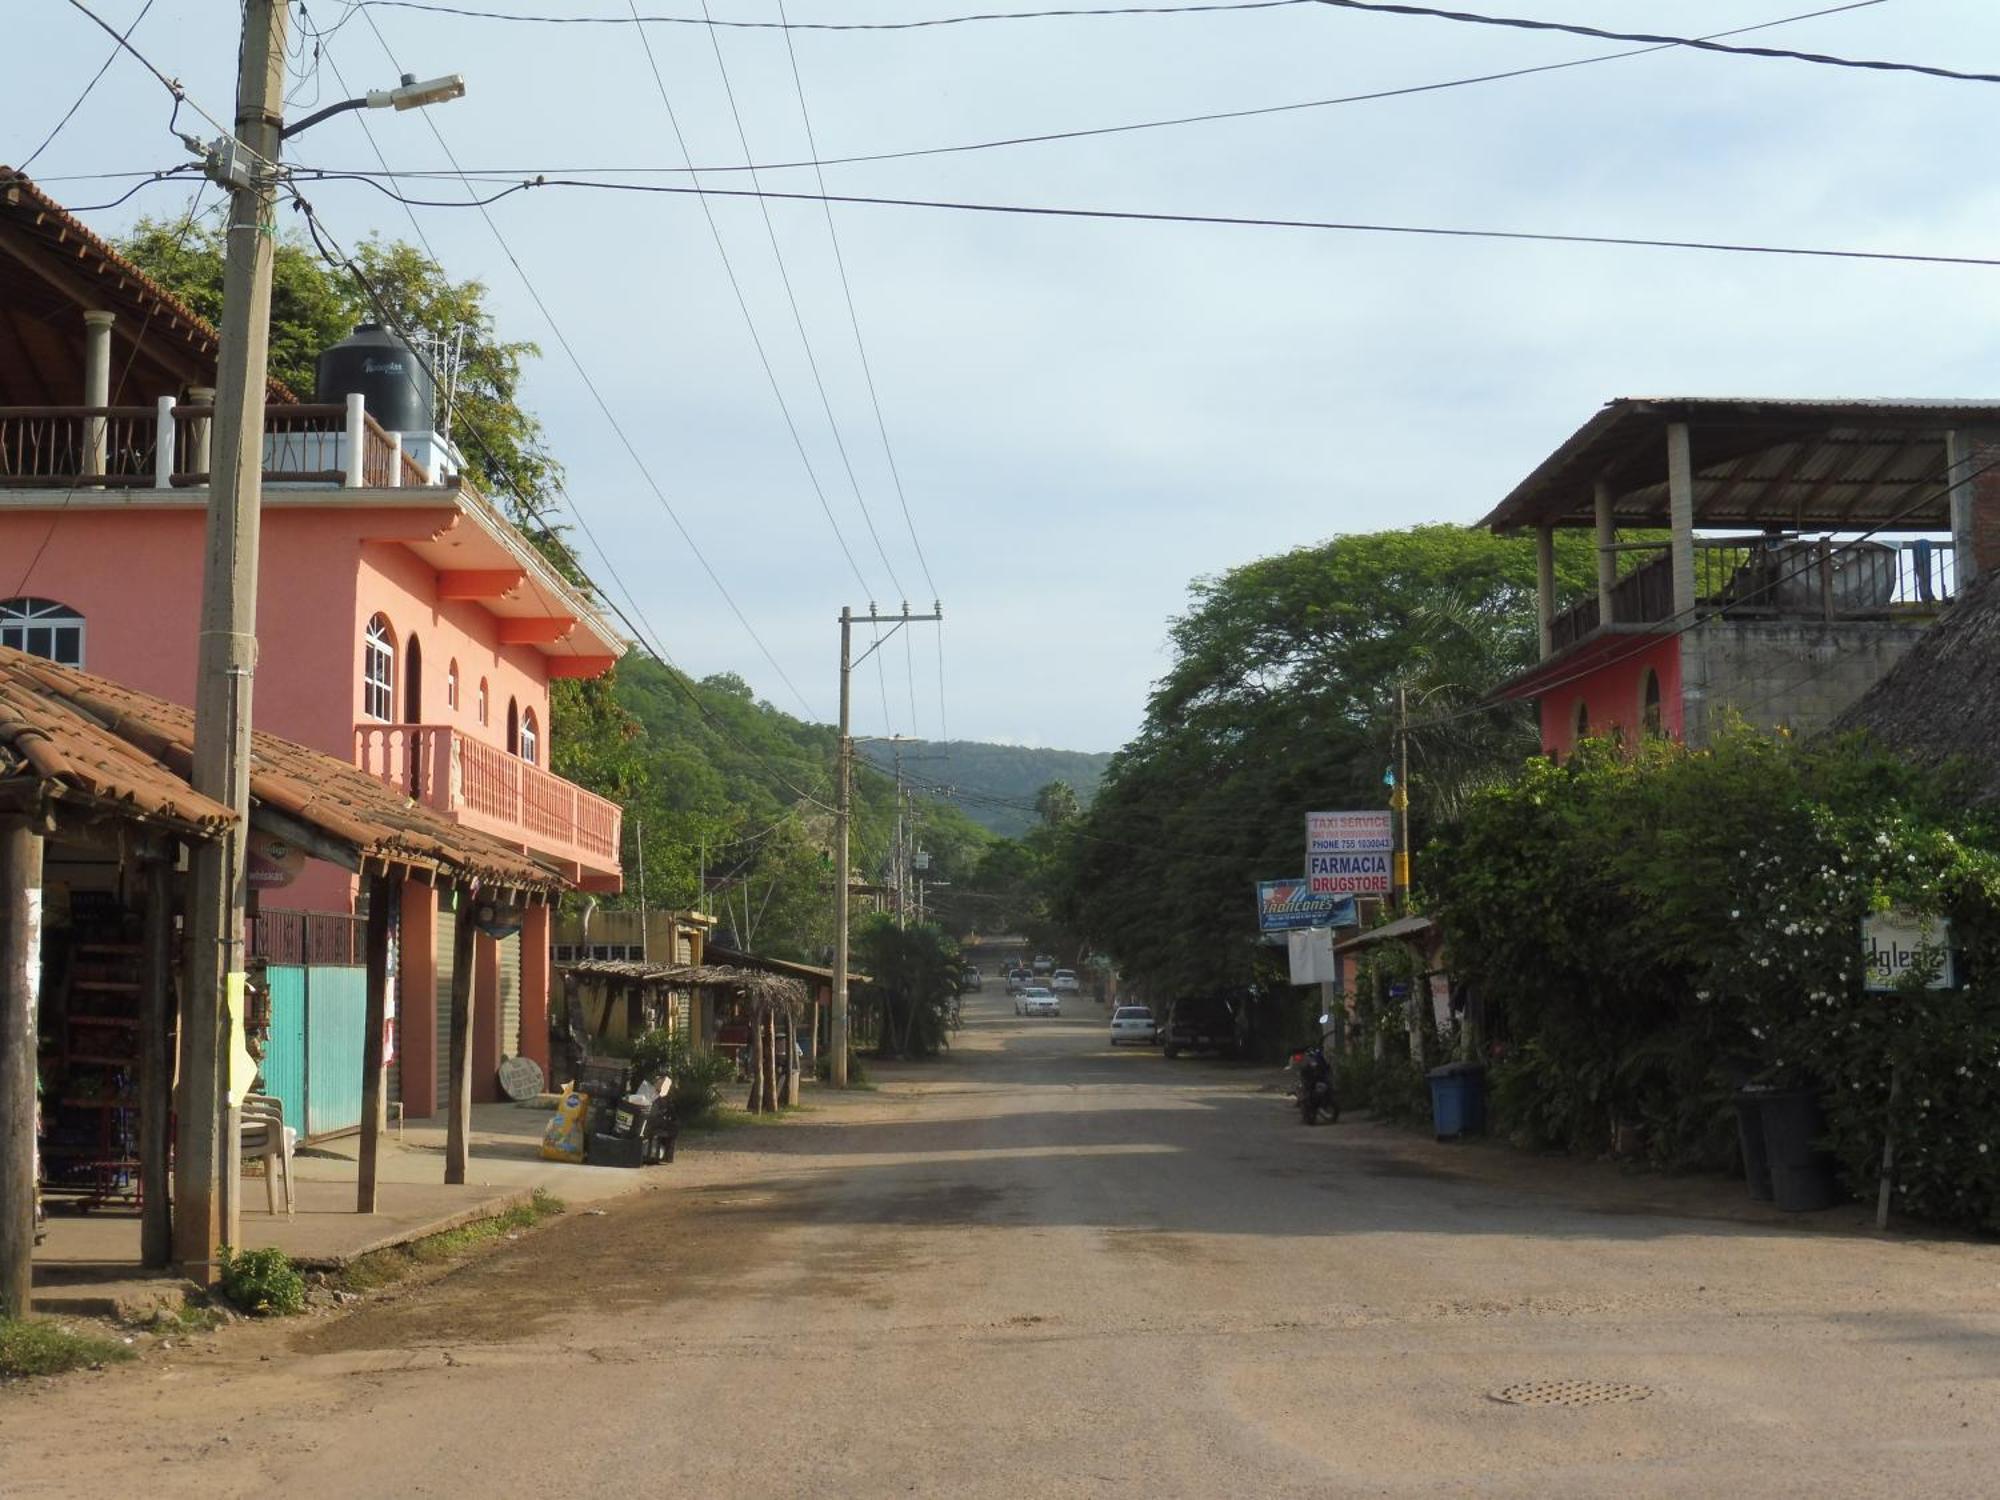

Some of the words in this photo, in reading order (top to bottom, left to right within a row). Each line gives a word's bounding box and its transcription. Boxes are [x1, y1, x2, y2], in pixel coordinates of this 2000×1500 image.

[1312, 816, 1338, 829] TAXI
[1341, 815, 1390, 828] SERVICE
[1312, 840, 1339, 849] PHONE
[1341, 839, 1356, 849] 755
[1312, 856, 1386, 874] FARMACIA
[1312, 875, 1389, 892] DRUGSTORE
